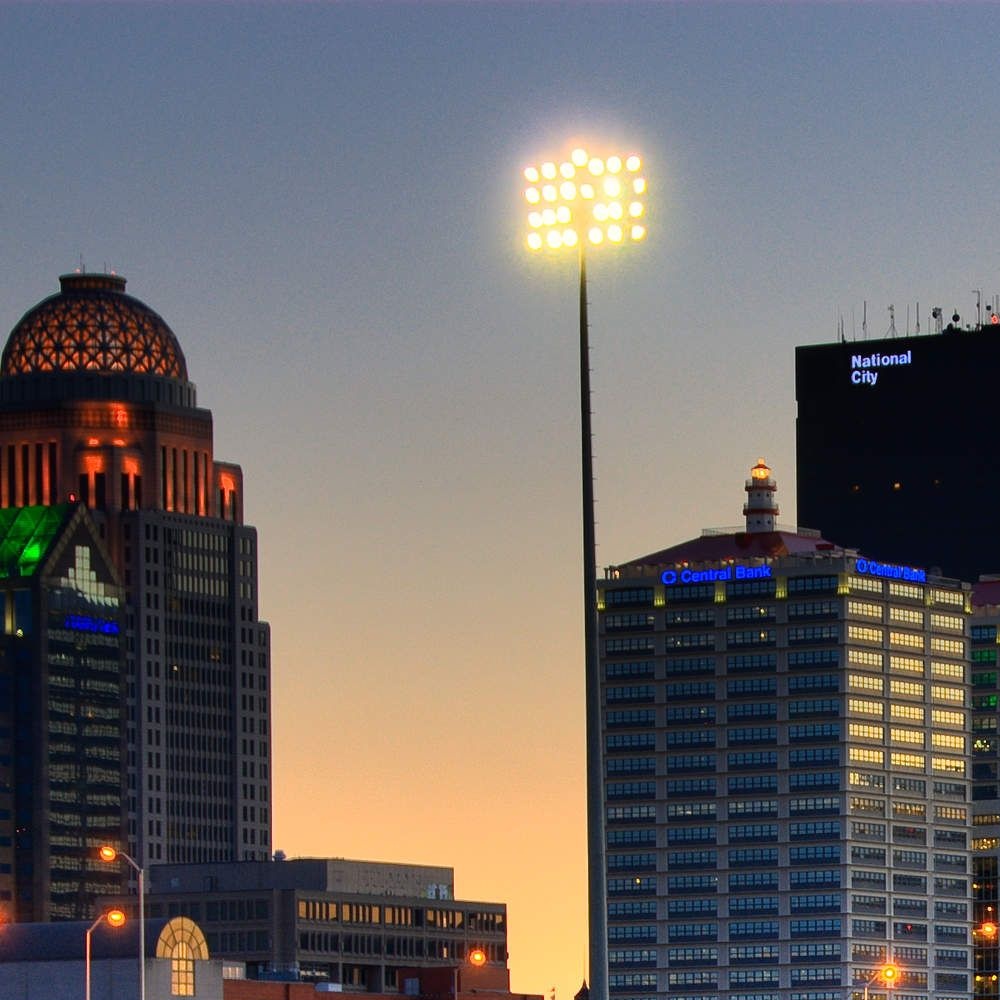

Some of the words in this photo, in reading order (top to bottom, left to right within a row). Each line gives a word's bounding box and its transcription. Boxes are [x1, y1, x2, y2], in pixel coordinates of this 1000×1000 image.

[851, 350, 912, 369] National
[851, 370, 878, 386] City
[681, 568, 731, 583] Central
[735, 564, 771, 579] Bank
